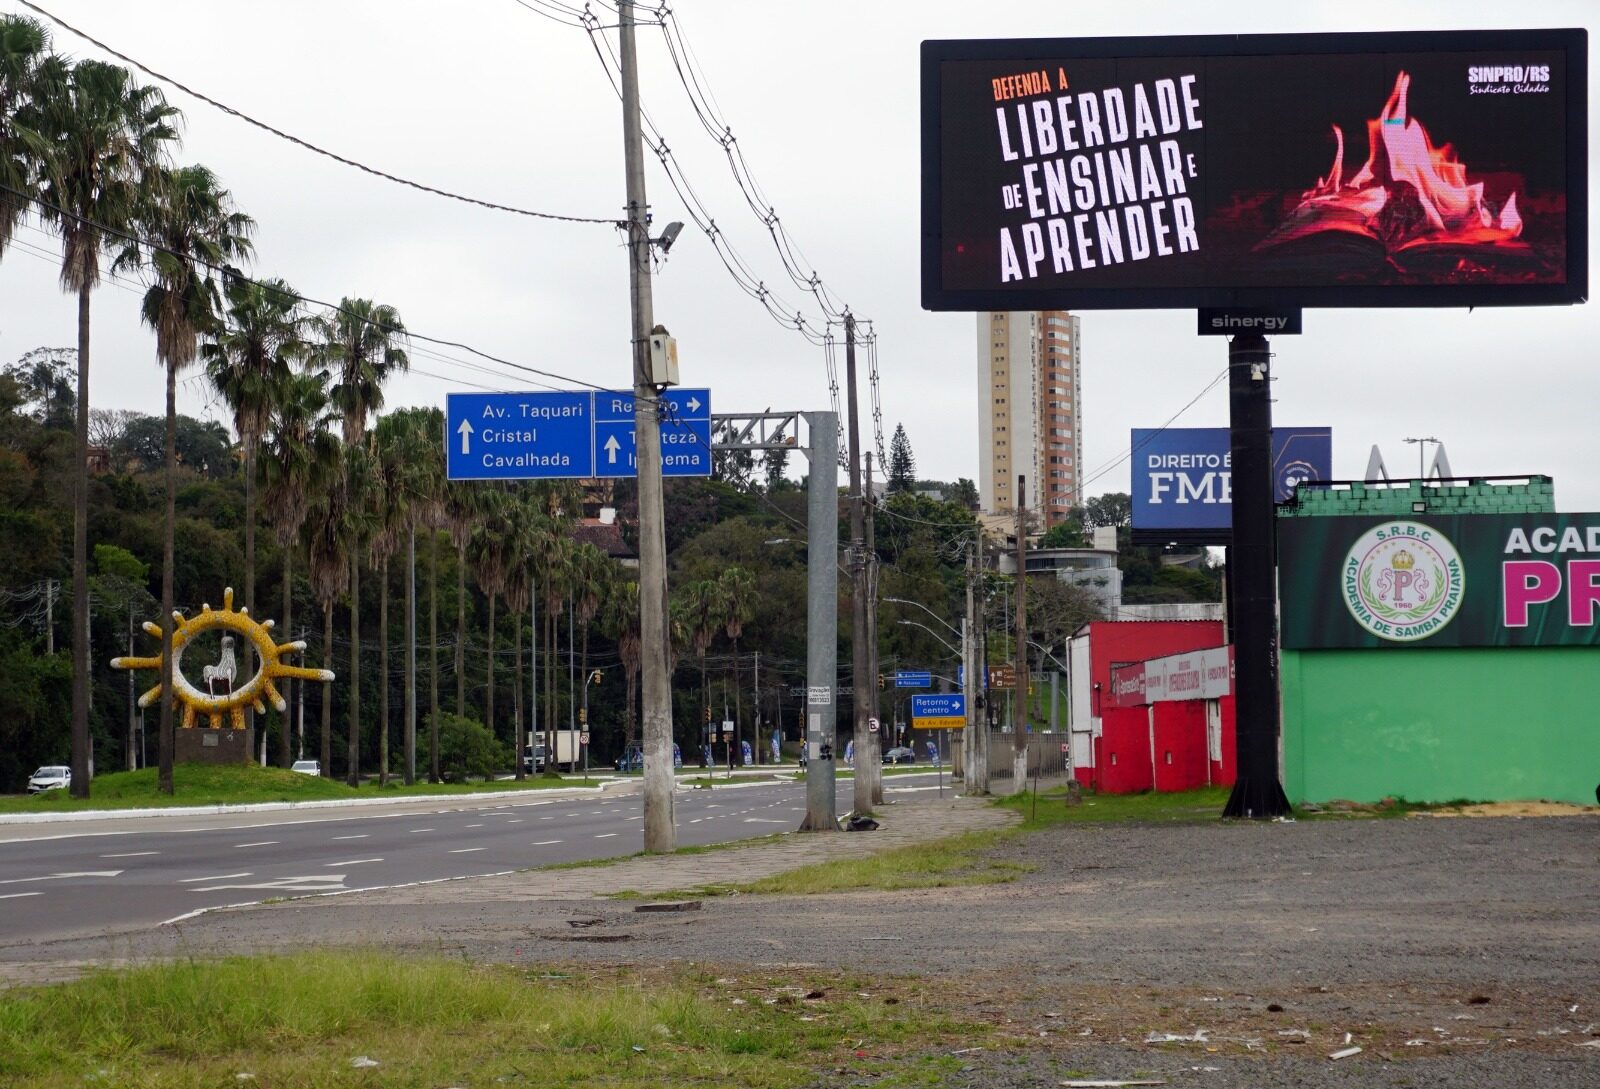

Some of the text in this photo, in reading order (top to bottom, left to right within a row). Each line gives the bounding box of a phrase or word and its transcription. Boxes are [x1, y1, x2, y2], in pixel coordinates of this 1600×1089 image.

[1468, 65, 1550, 84] SINPRO/RS
[992, 67, 1068, 101] DEFENDA A
[1470, 83, 1550, 95] Sindicato Cidadão
[996, 74, 1203, 162] LIBERDADE
[1002, 140, 1197, 218] DE ENSINAR E
[1000, 197, 1200, 283] APRENDER
[1212, 314, 1288, 329] sinergy
[482, 403, 583, 420] Av. Taquari
[482, 428, 537, 443] Cristal
[628, 431, 697, 445] Tteza
[482, 453, 570, 467] Cavalhada
[1148, 454, 1220, 468] DIREITO
[1376, 525, 1431, 541] S.R.B.C
[1346, 556, 1461, 637] ACADEMIA DE SAMBA PRAIANA
[916, 698, 949, 706] Retorno
